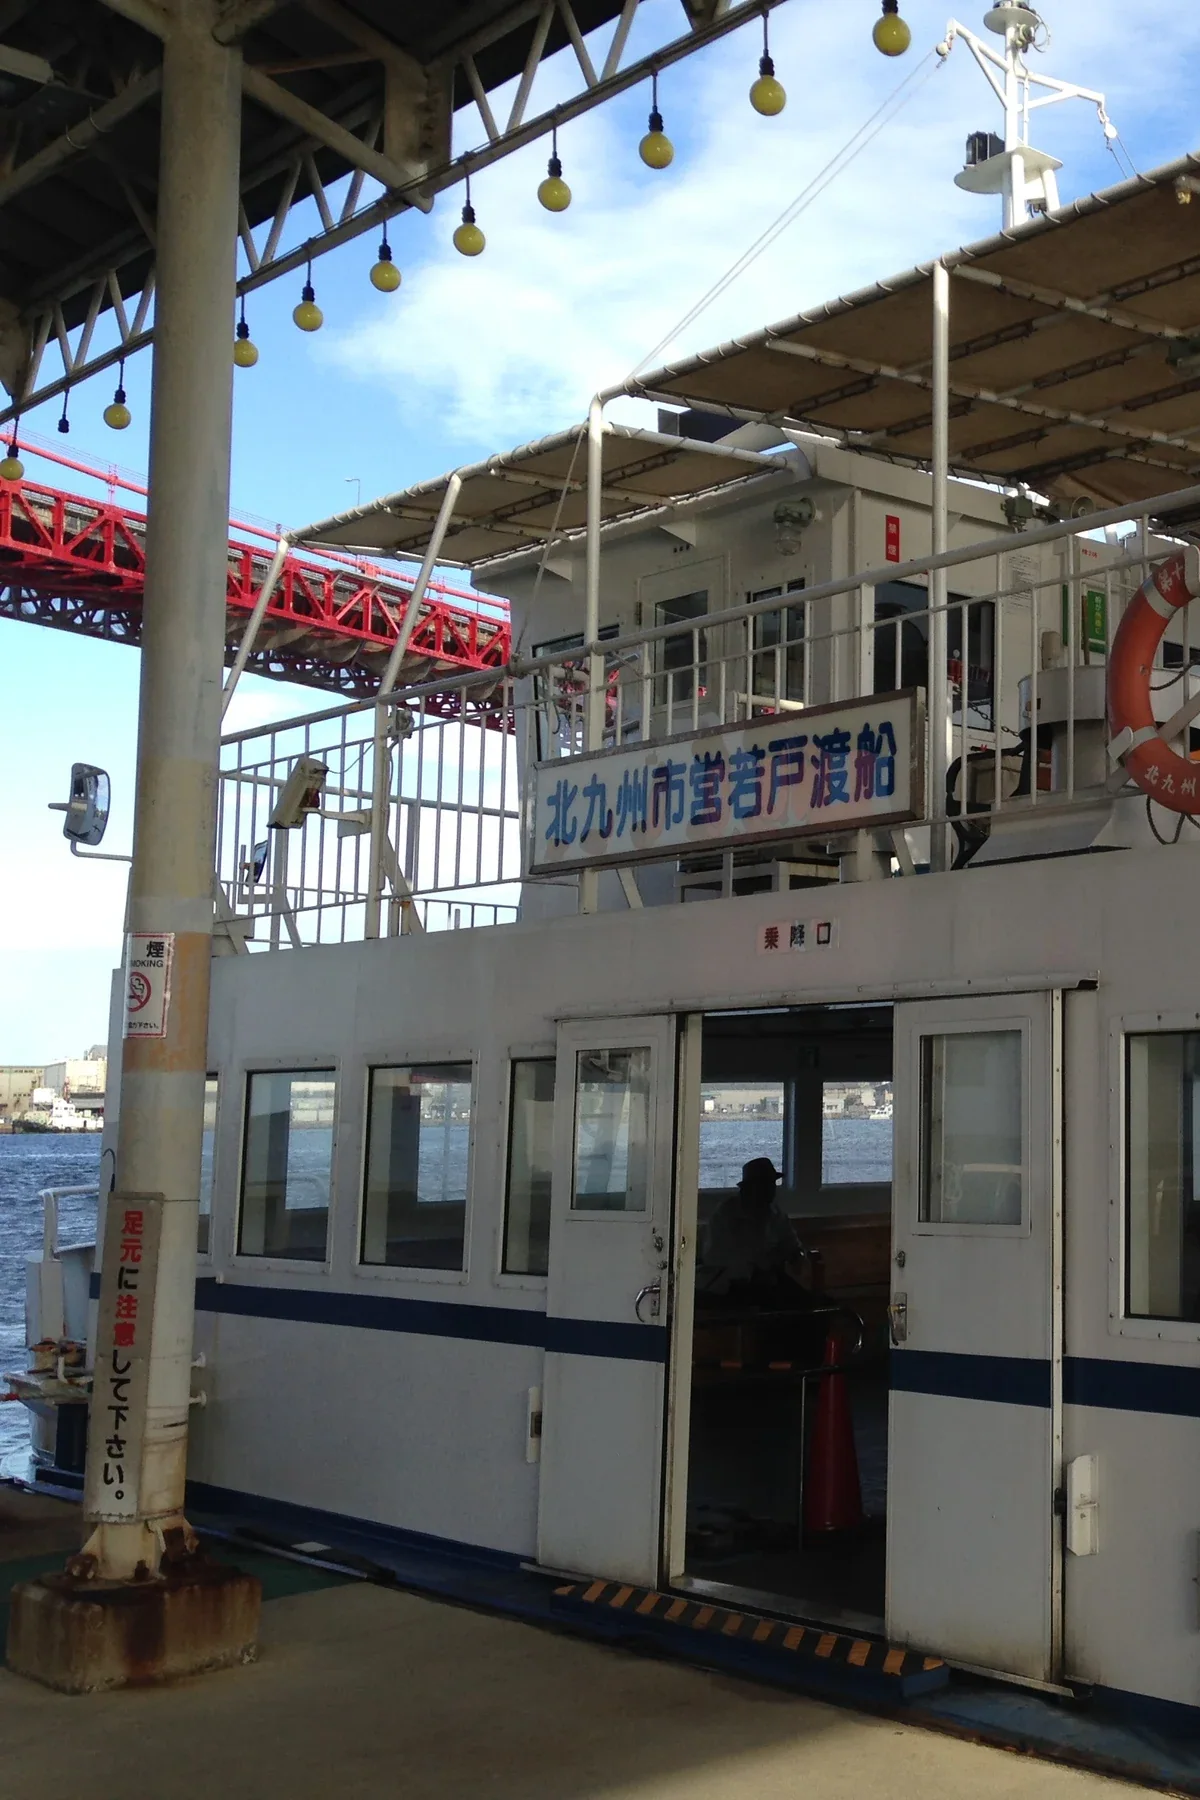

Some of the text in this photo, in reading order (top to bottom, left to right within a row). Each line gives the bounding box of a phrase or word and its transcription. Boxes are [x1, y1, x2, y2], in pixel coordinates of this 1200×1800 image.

[545, 720, 897, 848] 北九州市営若戸渡船
[764, 922, 832, 950] 乗降口
